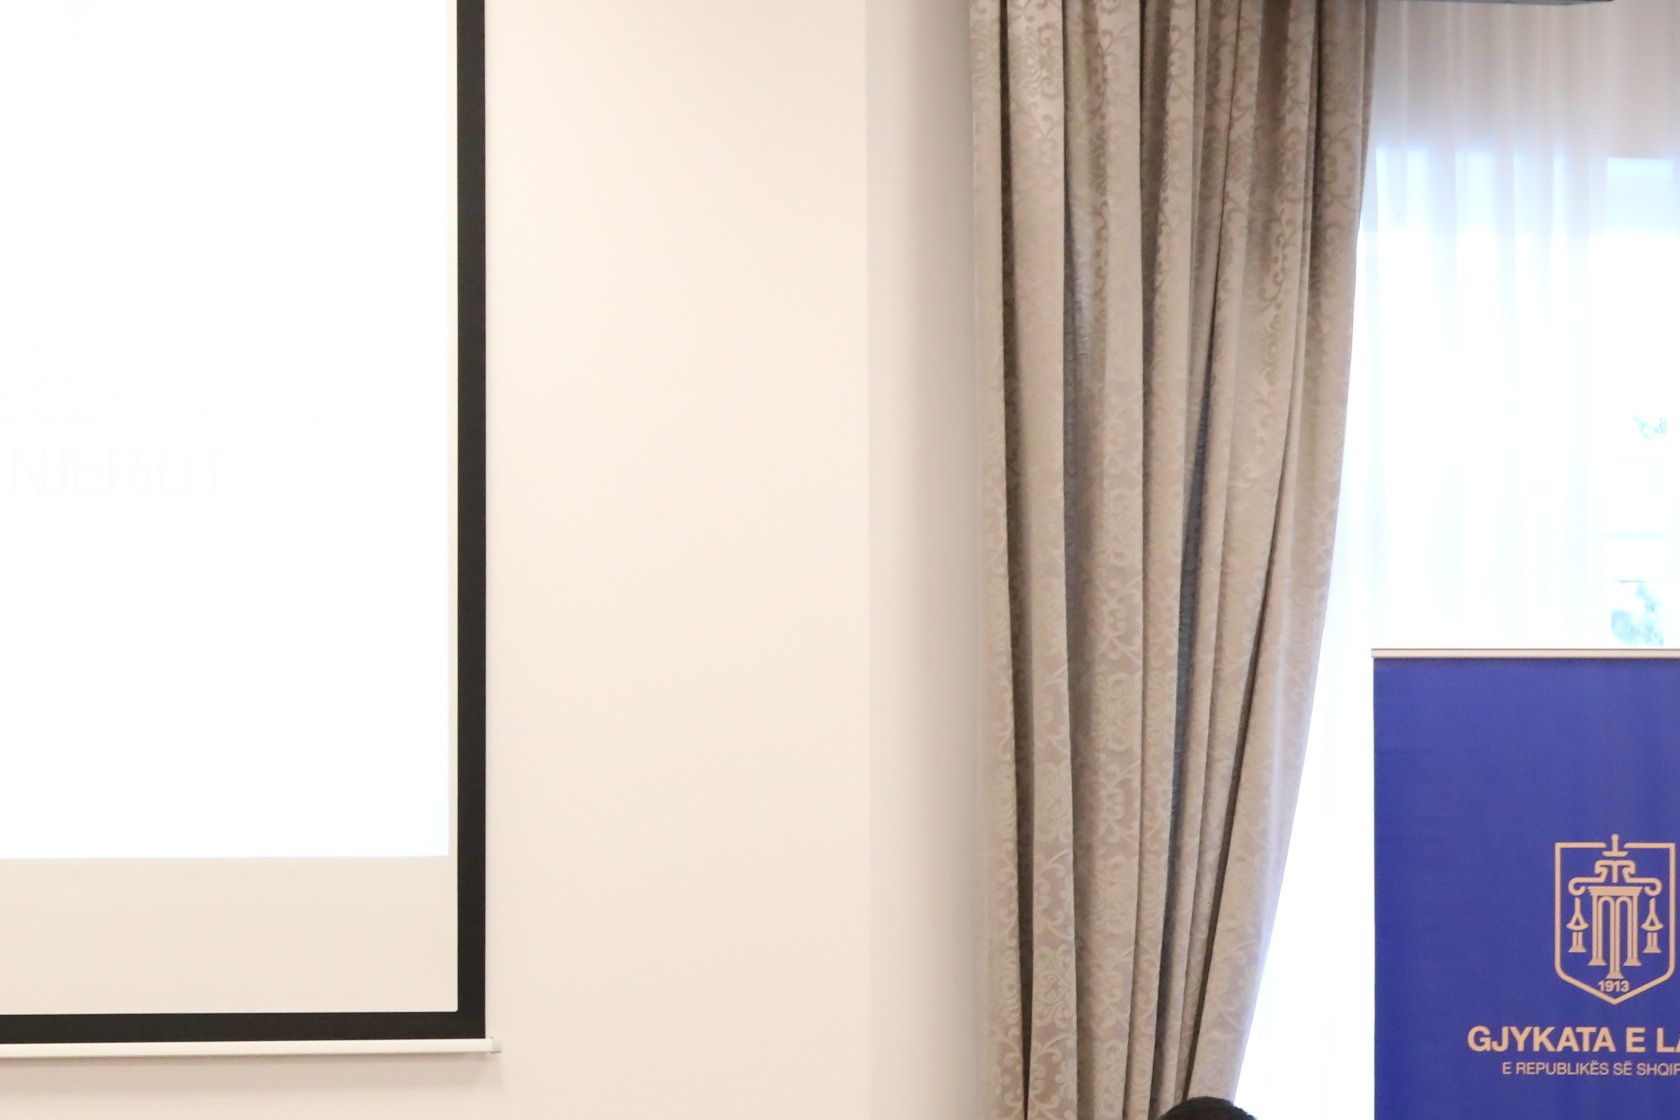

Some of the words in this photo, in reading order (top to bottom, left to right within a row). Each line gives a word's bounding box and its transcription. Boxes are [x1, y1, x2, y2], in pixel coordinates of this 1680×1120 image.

[1598, 980, 1629, 992] 1913
[1467, 1026, 1616, 1053] GJYKATA
[1626, 1026, 1646, 1053] E
[1502, 1062, 1511, 1074] E
[1516, 1059, 1610, 1076] REPUBLIKËS
[1613, 1059, 1632, 1076] SË
